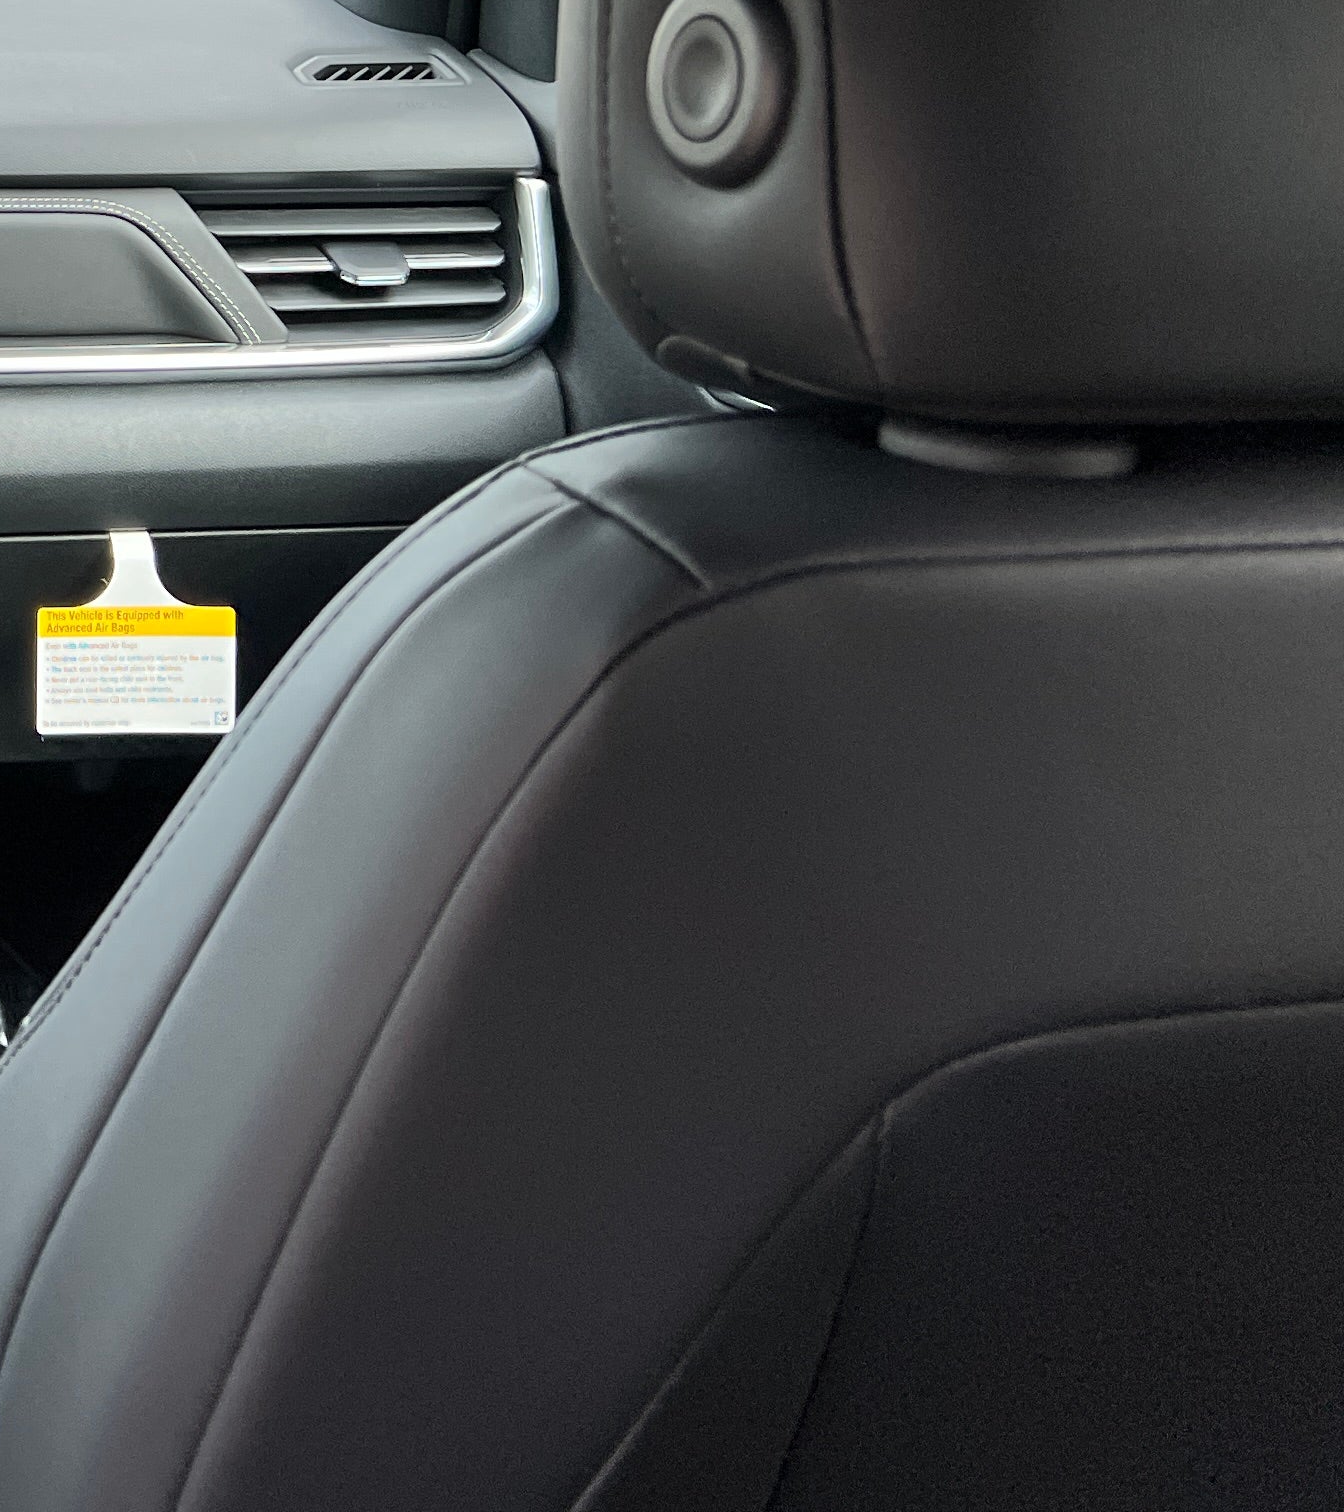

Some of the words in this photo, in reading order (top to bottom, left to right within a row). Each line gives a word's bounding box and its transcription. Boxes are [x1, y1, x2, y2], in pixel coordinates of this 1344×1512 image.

[47, 612, 66, 621] This
[69, 611, 102, 620] Vehicle
[106, 611, 113, 620] is
[117, 610, 160, 622] Equipped
[163, 610, 183, 619] with
[47, 624, 92, 633] Advanced
[95, 623, 108, 632] Air
[112, 623, 135, 634] Bags
